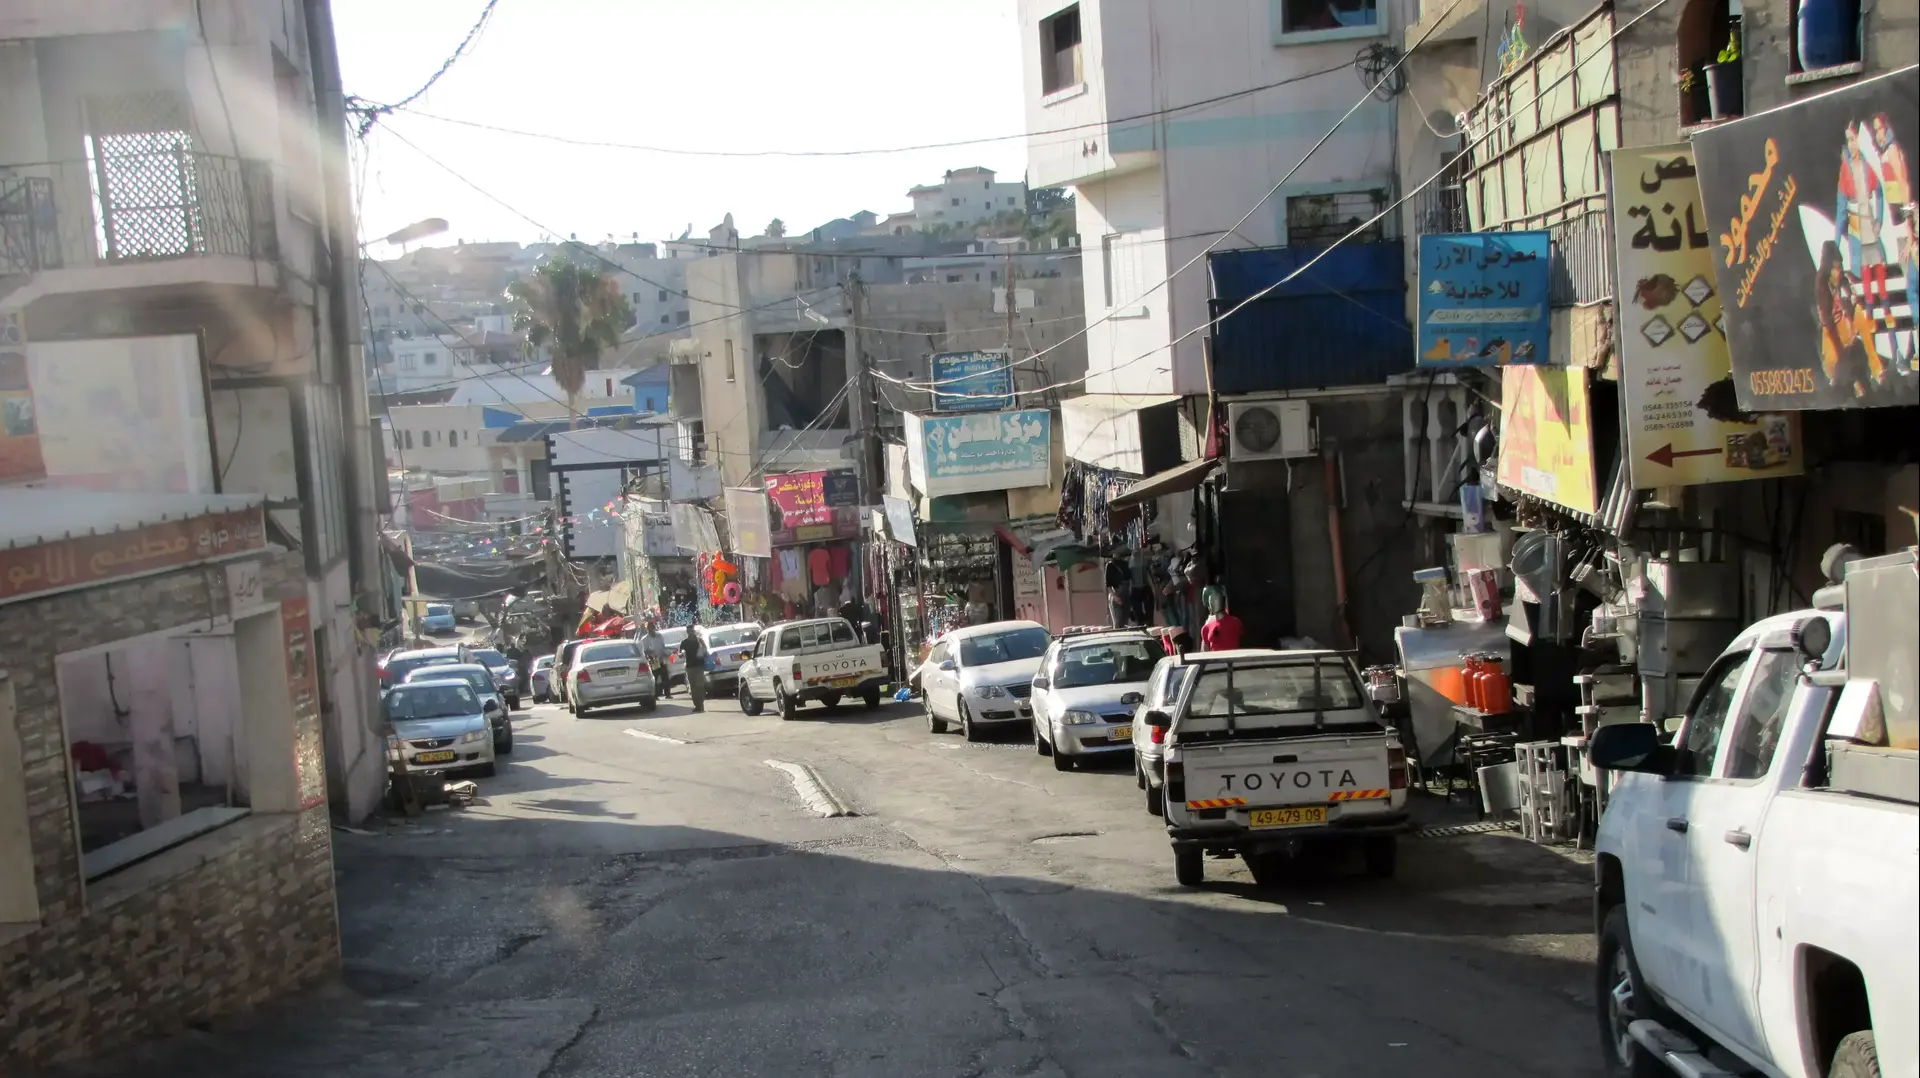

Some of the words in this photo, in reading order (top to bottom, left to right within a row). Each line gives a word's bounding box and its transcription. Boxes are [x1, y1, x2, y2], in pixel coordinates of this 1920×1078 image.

[1719, 137, 1780, 268] محمود
[1769, 173, 1797, 244] للشباب
[1476, 243, 1537, 270] معرض
[1445, 280, 1520, 305] للاحذية
[1750, 368, 1815, 396] 0559832425
[1003, 413, 1042, 444] مركز
[0, 547, 76, 590] الانو
[89, 534, 190, 575] مطعم
[813, 659, 867, 673] TOYOTA
[1221, 769, 1357, 791] TOYOTA
